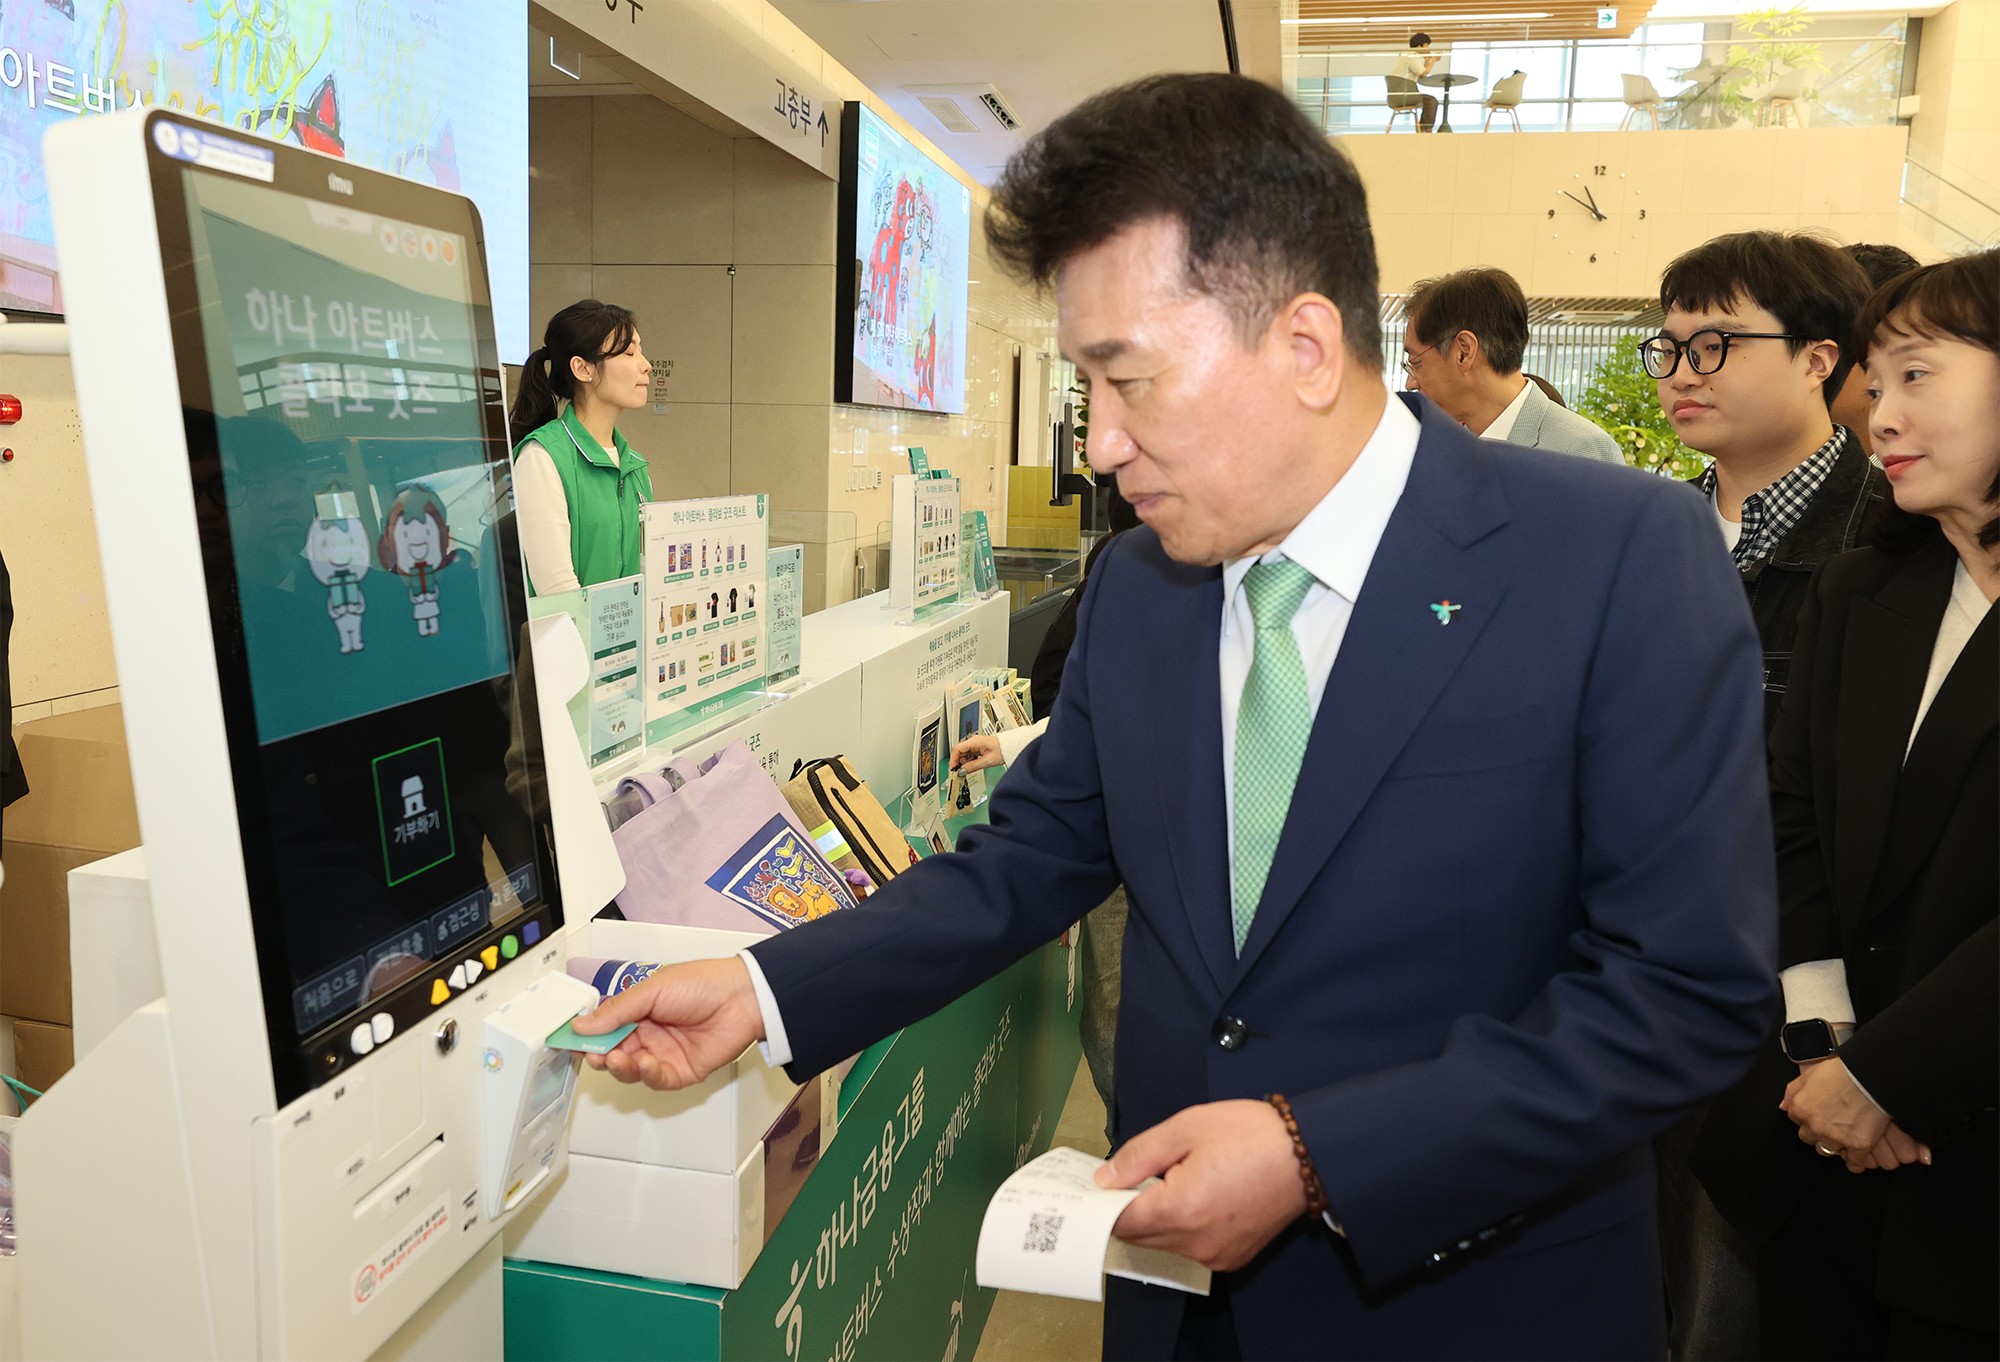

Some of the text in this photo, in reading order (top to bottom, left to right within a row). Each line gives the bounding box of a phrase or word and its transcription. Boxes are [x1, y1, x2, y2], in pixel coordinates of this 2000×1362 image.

[774, 78, 811, 136] 고층부
[1594, 165, 1606, 176] 12
[1548, 209, 1555, 219] 9
[1639, 209, 1646, 220] 3
[1589, 253, 1597, 263] 6
[246, 288, 443, 358] 하나 아트버스
[277, 361, 438, 420] 콜라보 굿즈
[749, 732, 761, 752] 굿즈
[393, 810, 440, 844] 기부하기
[450, 901, 480, 933] 접근성
[304, 968, 359, 1015] 처음으로
[887, 1158, 932, 1279] 수상작과
[935, 1091, 971, 1186] 함께하는
[973, 1034, 996, 1108] 콜라보
[997, 1004, 1011, 1060] 굿즈
[816, 1066, 925, 1289] 하나금융그룹
